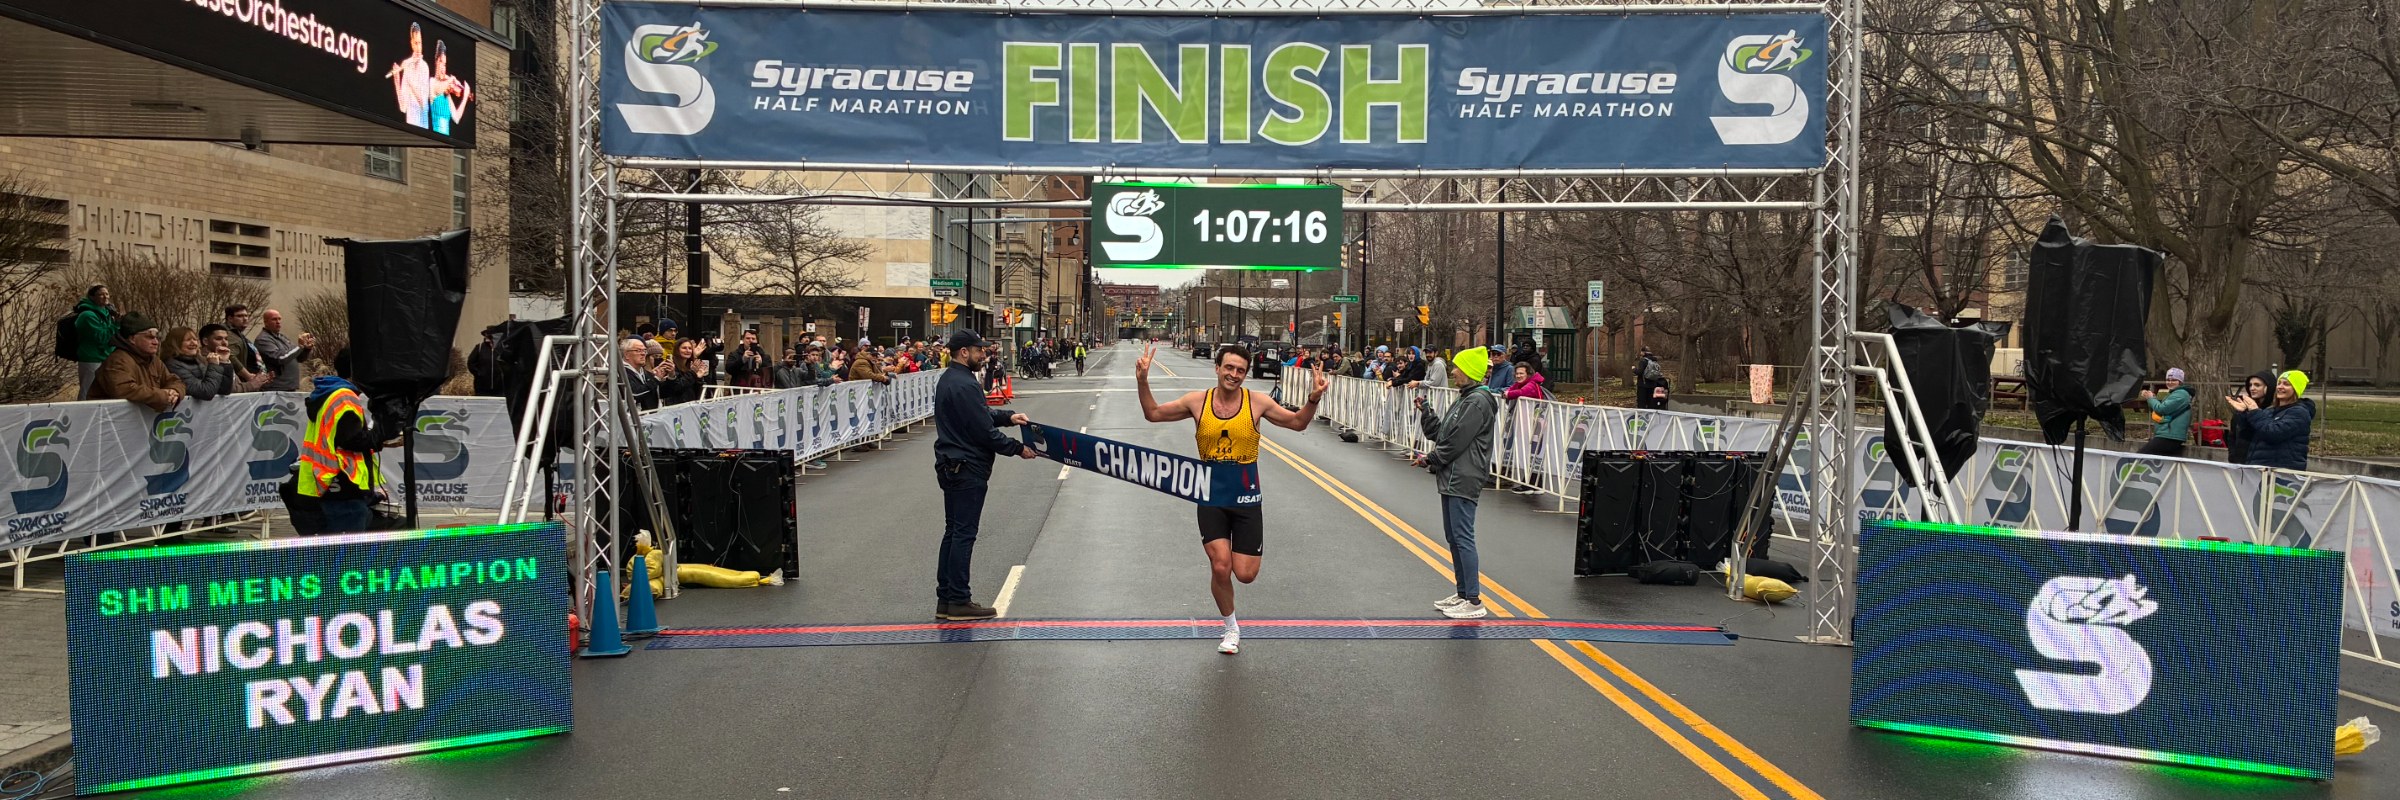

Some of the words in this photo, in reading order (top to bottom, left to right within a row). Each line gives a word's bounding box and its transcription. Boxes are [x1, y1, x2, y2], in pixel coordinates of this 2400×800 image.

[751, 59, 974, 96] Syracuse
[1002, 41, 1429, 144] FINISH
[1456, 67, 1677, 103] Syracuse
[754, 96, 819, 112] HALF
[830, 98, 970, 115] MARATHON
[1459, 103, 1523, 118] HALF
[1533, 102, 1673, 118] MARATHON
[1193, 209, 1328, 244] 1:07:16
[245, 481, 281, 496] SYRACU
[397, 483, 469, 495] SRACUSE
[1094, 441, 1212, 502] CHAMPION
[100, 586, 190, 617] SHM
[209, 574, 322, 606] MENS
[340, 556, 538, 597] CHAMPION
[151, 600, 505, 679] NICHOLAS
[246, 663, 425, 730] RYAN
